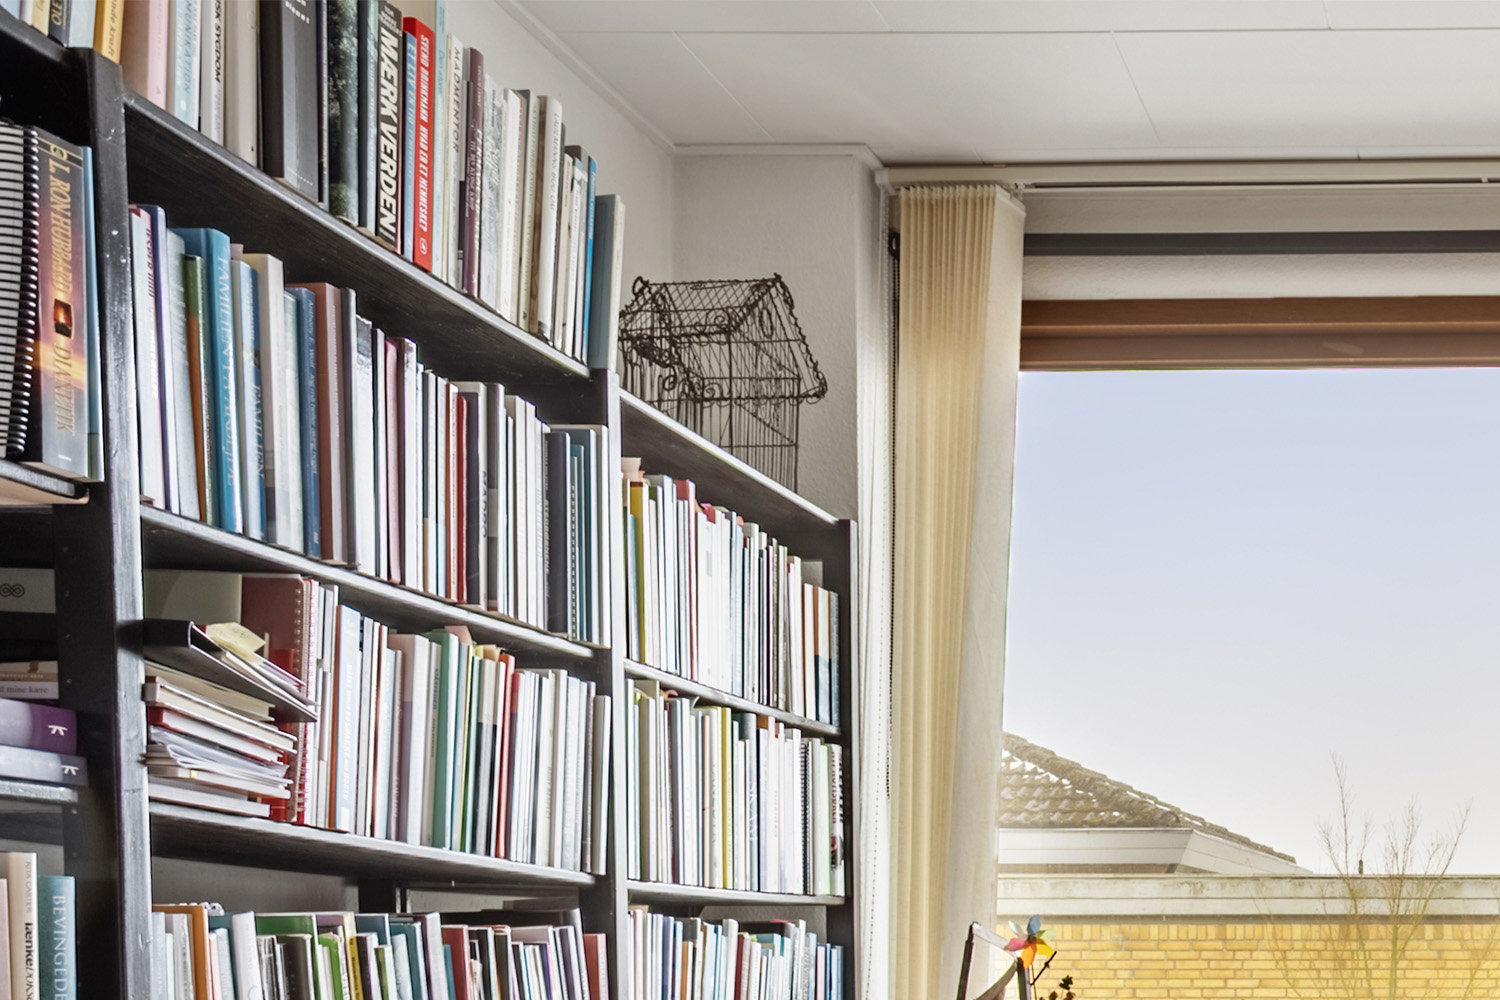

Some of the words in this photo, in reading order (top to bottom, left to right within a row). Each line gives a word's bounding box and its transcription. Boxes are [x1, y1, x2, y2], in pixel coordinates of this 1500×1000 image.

[214, 23, 222, 83] SYGDOM
[379, 27, 399, 123] MÆRK
[419, 35, 430, 67] SVEND
[419, 66, 430, 124] BRINKMANN
[452, 47, 461, 154] MADMENTOR
[418, 125, 429, 150] HVAD
[418, 149, 428, 164] ER
[50, 179, 71, 208] RON
[379, 122, 399, 229] VERDEN
[418, 163, 428, 175] ET
[418, 175, 428, 231] MENNESKE?
[51, 208, 73, 292] HUBBARD
[217, 256, 232, 356] FAMILIEN
[53, 345, 75, 436] DIANETIK
[251, 384, 265, 479] FAMILIEN
